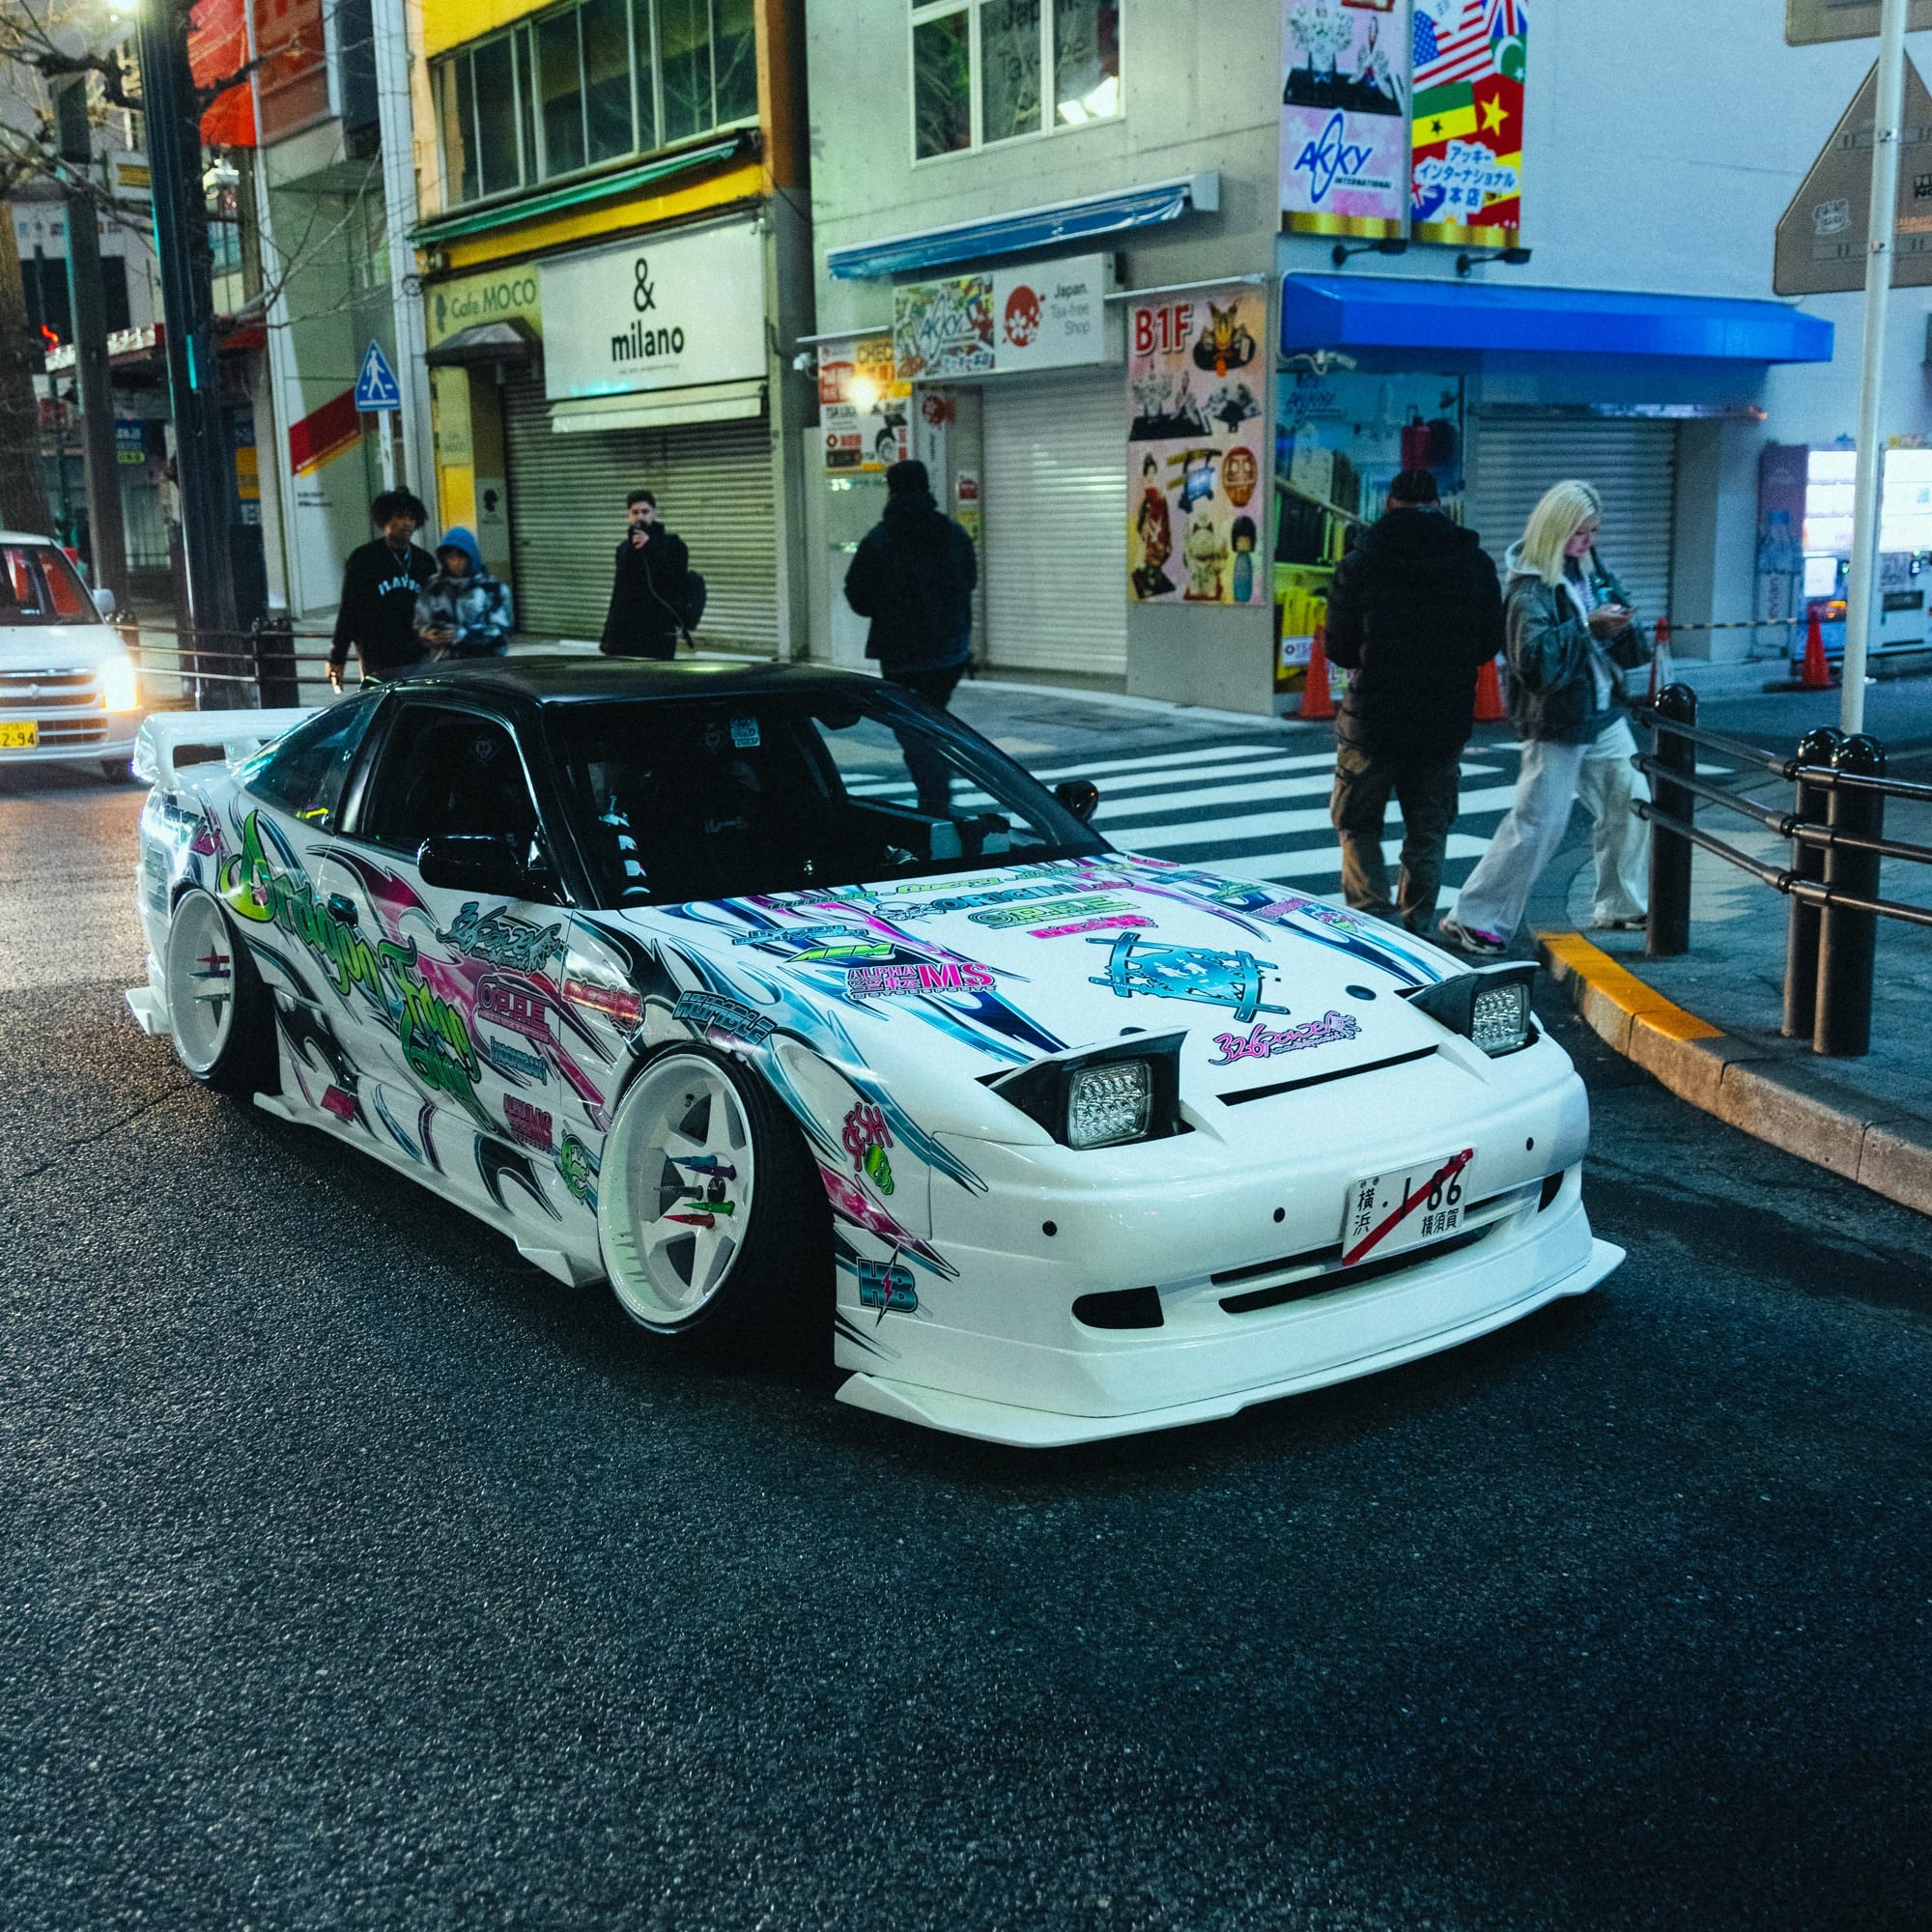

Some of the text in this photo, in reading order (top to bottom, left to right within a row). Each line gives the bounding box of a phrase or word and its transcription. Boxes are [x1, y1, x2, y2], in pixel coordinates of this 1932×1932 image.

[1450, 146, 1492, 163] アッキー
[1420, 162, 1516, 188] インターナショナル
[1449, 187, 1481, 207] 本店
[484, 278, 537, 314] MOCO
[633, 257, 657, 312] &
[1054, 283, 1088, 298] Japan
[611, 320, 685, 362] milano
[1065, 320, 1091, 336] Shop
[1134, 302, 1195, 356] B1F
[930, 883, 1081, 911] ORIGIN
[849, 963, 995, 988] ALPHA MS
[1352, 1188, 1376, 1236] 横浜
[1421, 1208, 1460, 1237] 横須賀
[857, 1256, 919, 1314] HB
